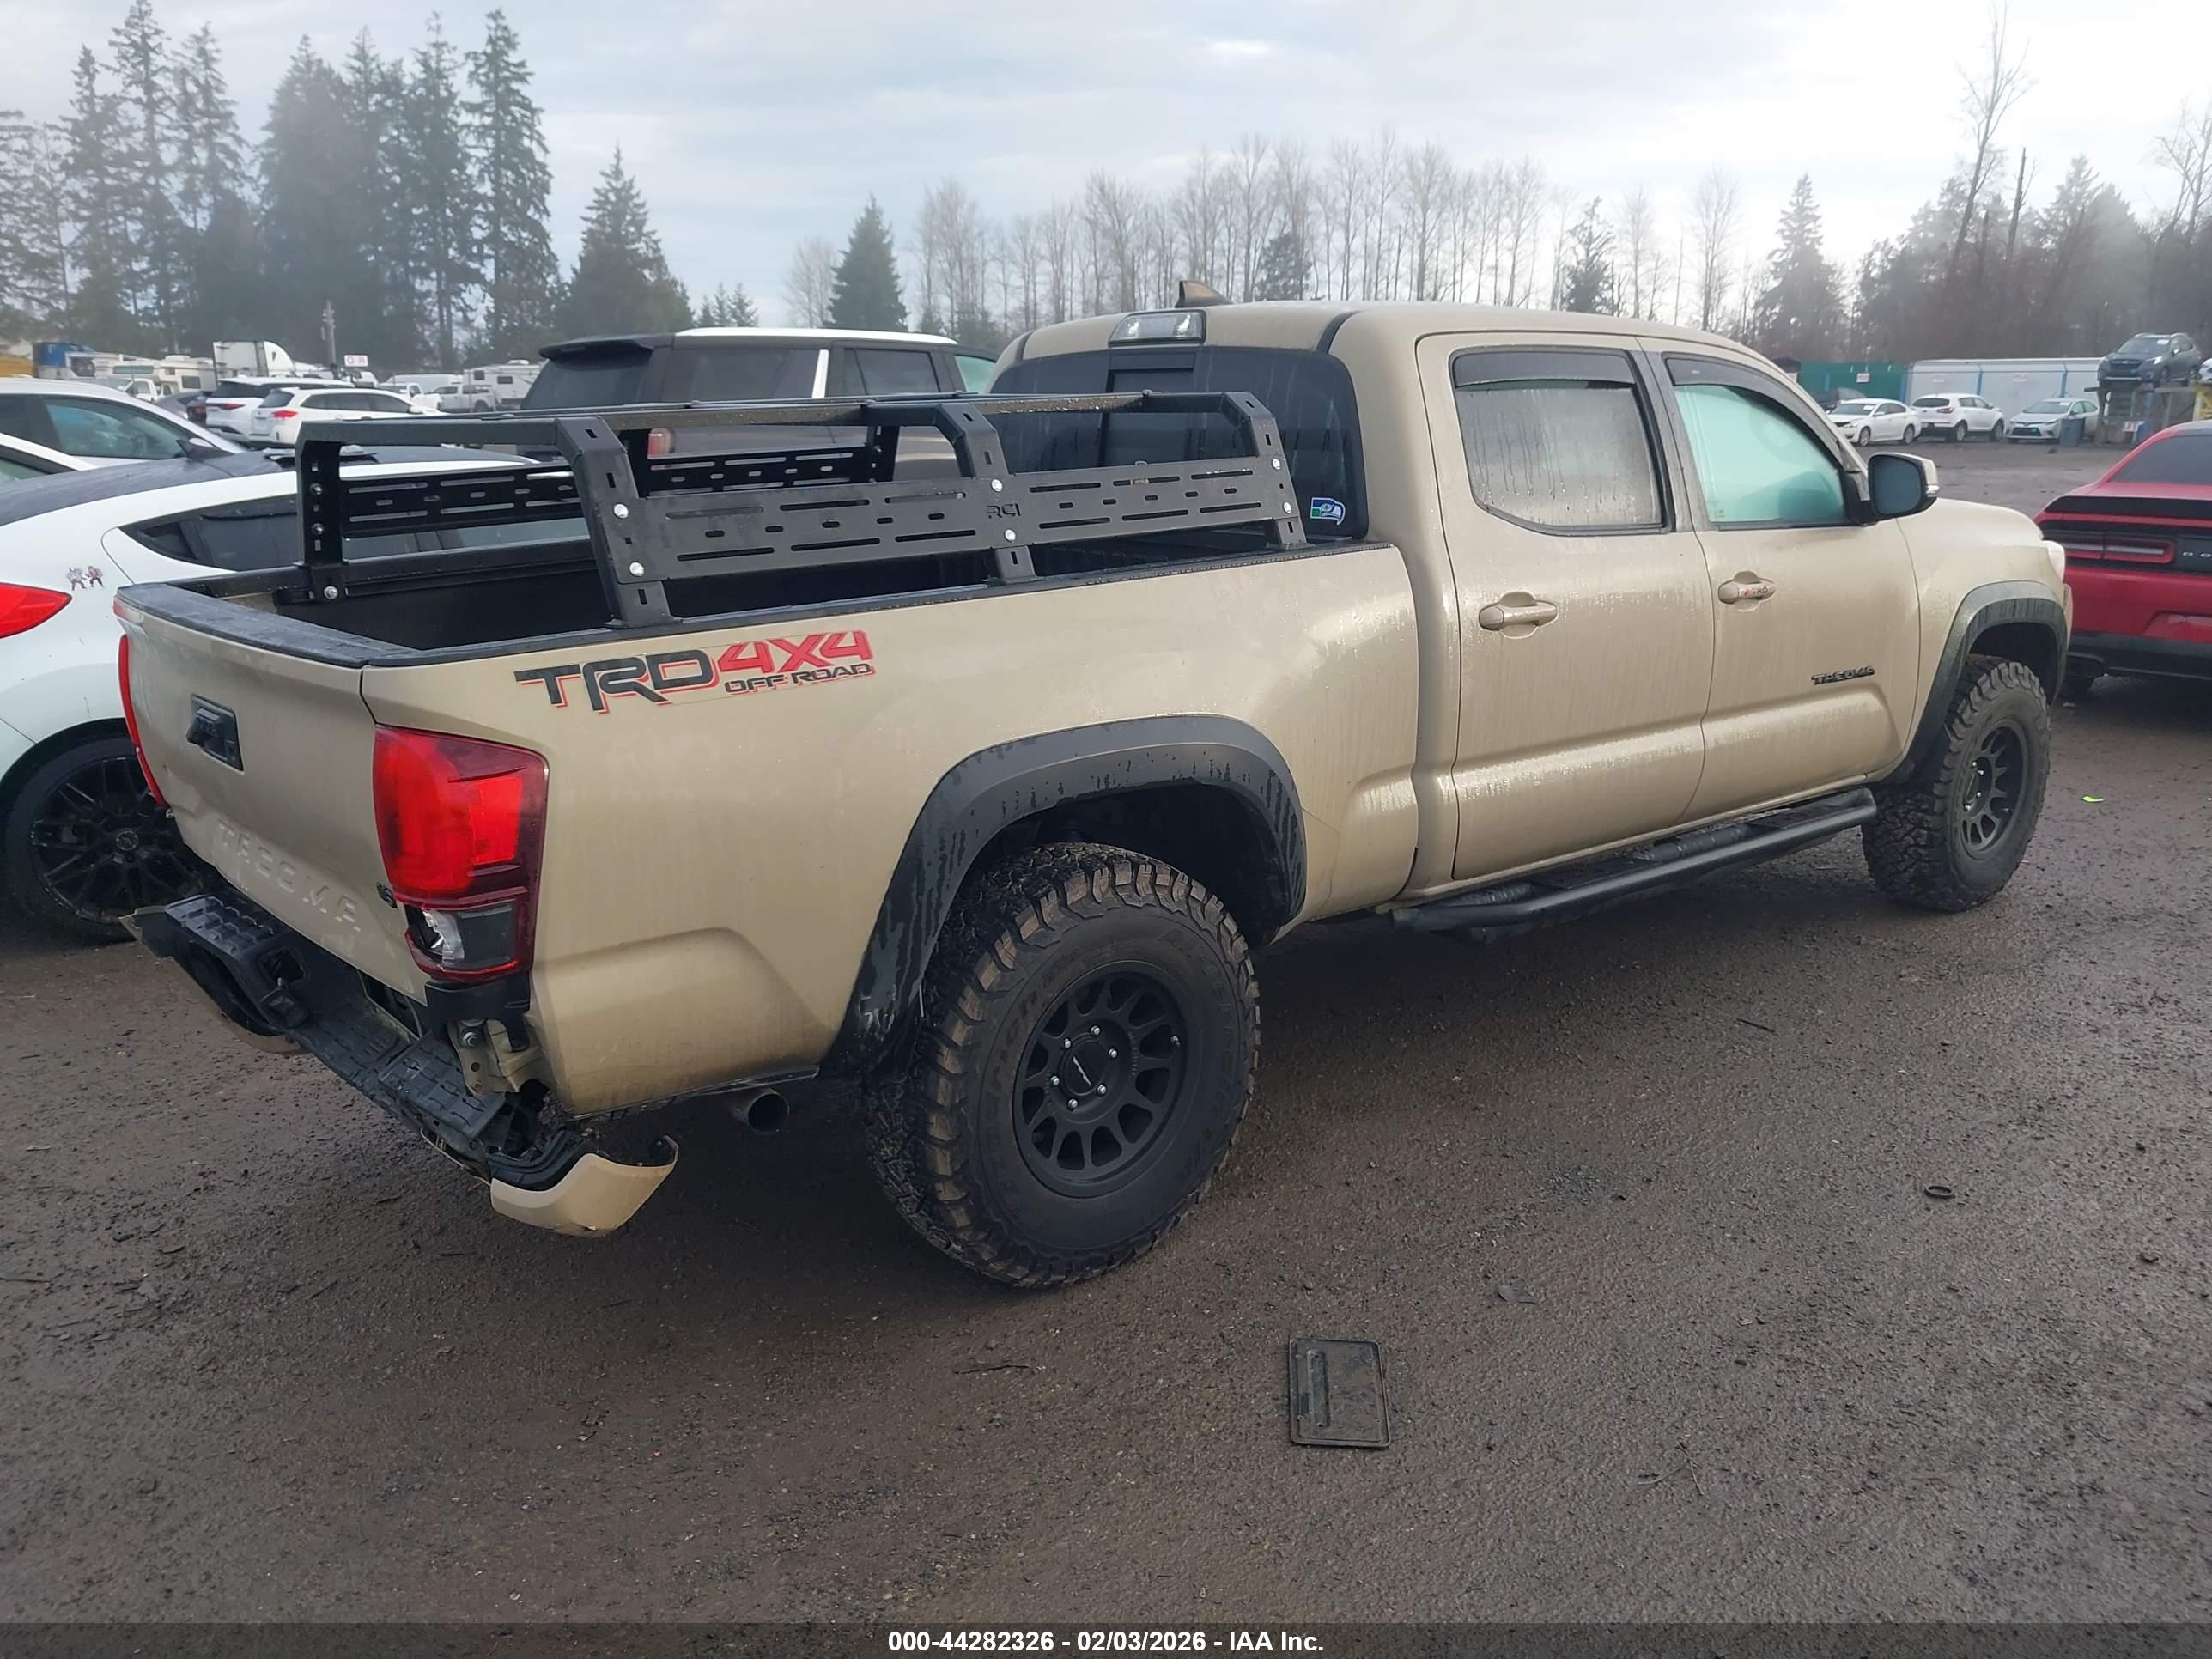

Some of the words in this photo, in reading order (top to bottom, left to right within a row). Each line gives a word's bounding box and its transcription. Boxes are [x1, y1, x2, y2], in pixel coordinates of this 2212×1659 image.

[514, 649, 720, 714] TRD
[723, 673, 789, 695] OFF
[791, 662, 876, 687] ROAD
